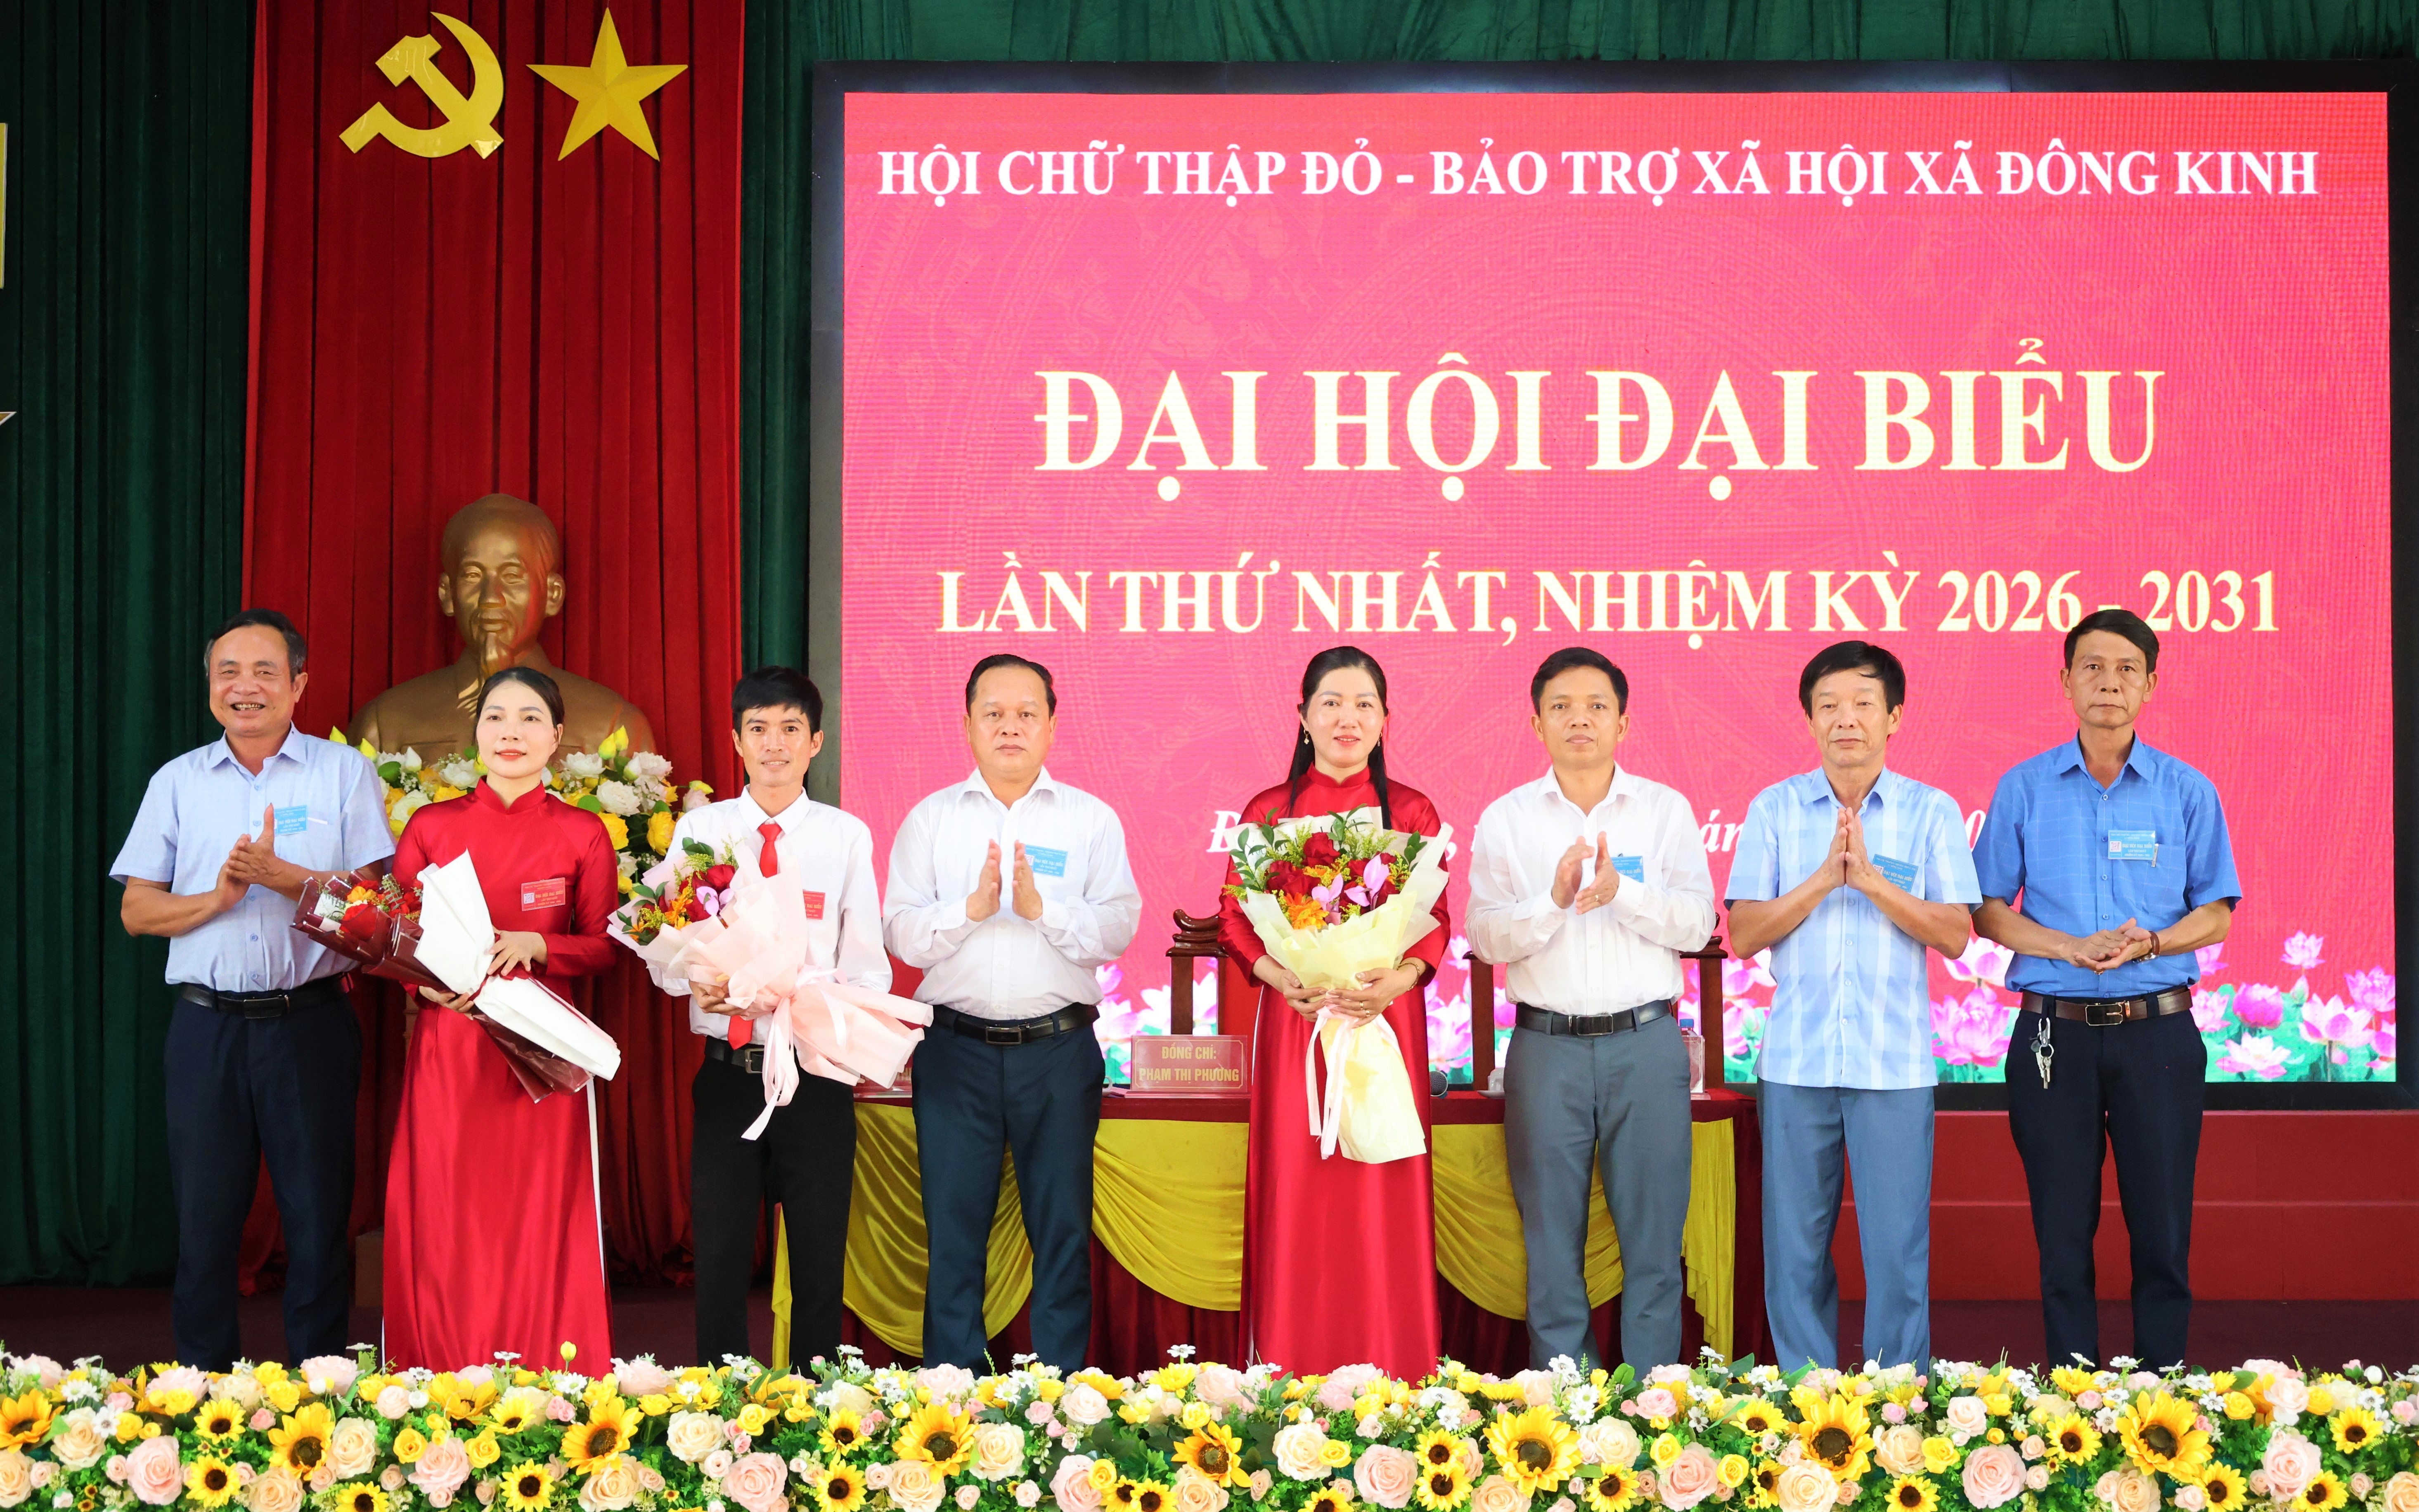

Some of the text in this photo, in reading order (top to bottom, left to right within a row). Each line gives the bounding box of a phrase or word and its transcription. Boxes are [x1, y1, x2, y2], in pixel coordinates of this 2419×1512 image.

[878, 138, 2317, 207] HỘI CHỮ THẬP ĐỎ - BẢO TRỢ XÃ HỘI XÃ ĐÔNG KINH
[1034, 338, 2165, 502] ĐẠI HỘI ĐẠI BIỂU
[936, 551, 1093, 633] LẦN
[1109, 551, 1280, 634] THỨ
[1292, 551, 1517, 646] NHẤT,
[1533, 560, 1792, 650] NHIỆM
[1809, 550, 1920, 631] KỲ
[1937, 570, 2081, 632] 2026
[2140, 570, 2278, 632] 2031
[1138, 1066, 1239, 1084] PHẠM THỊ PHƯƠNG
[1195, 1044, 1217, 1059] CHÍ:
